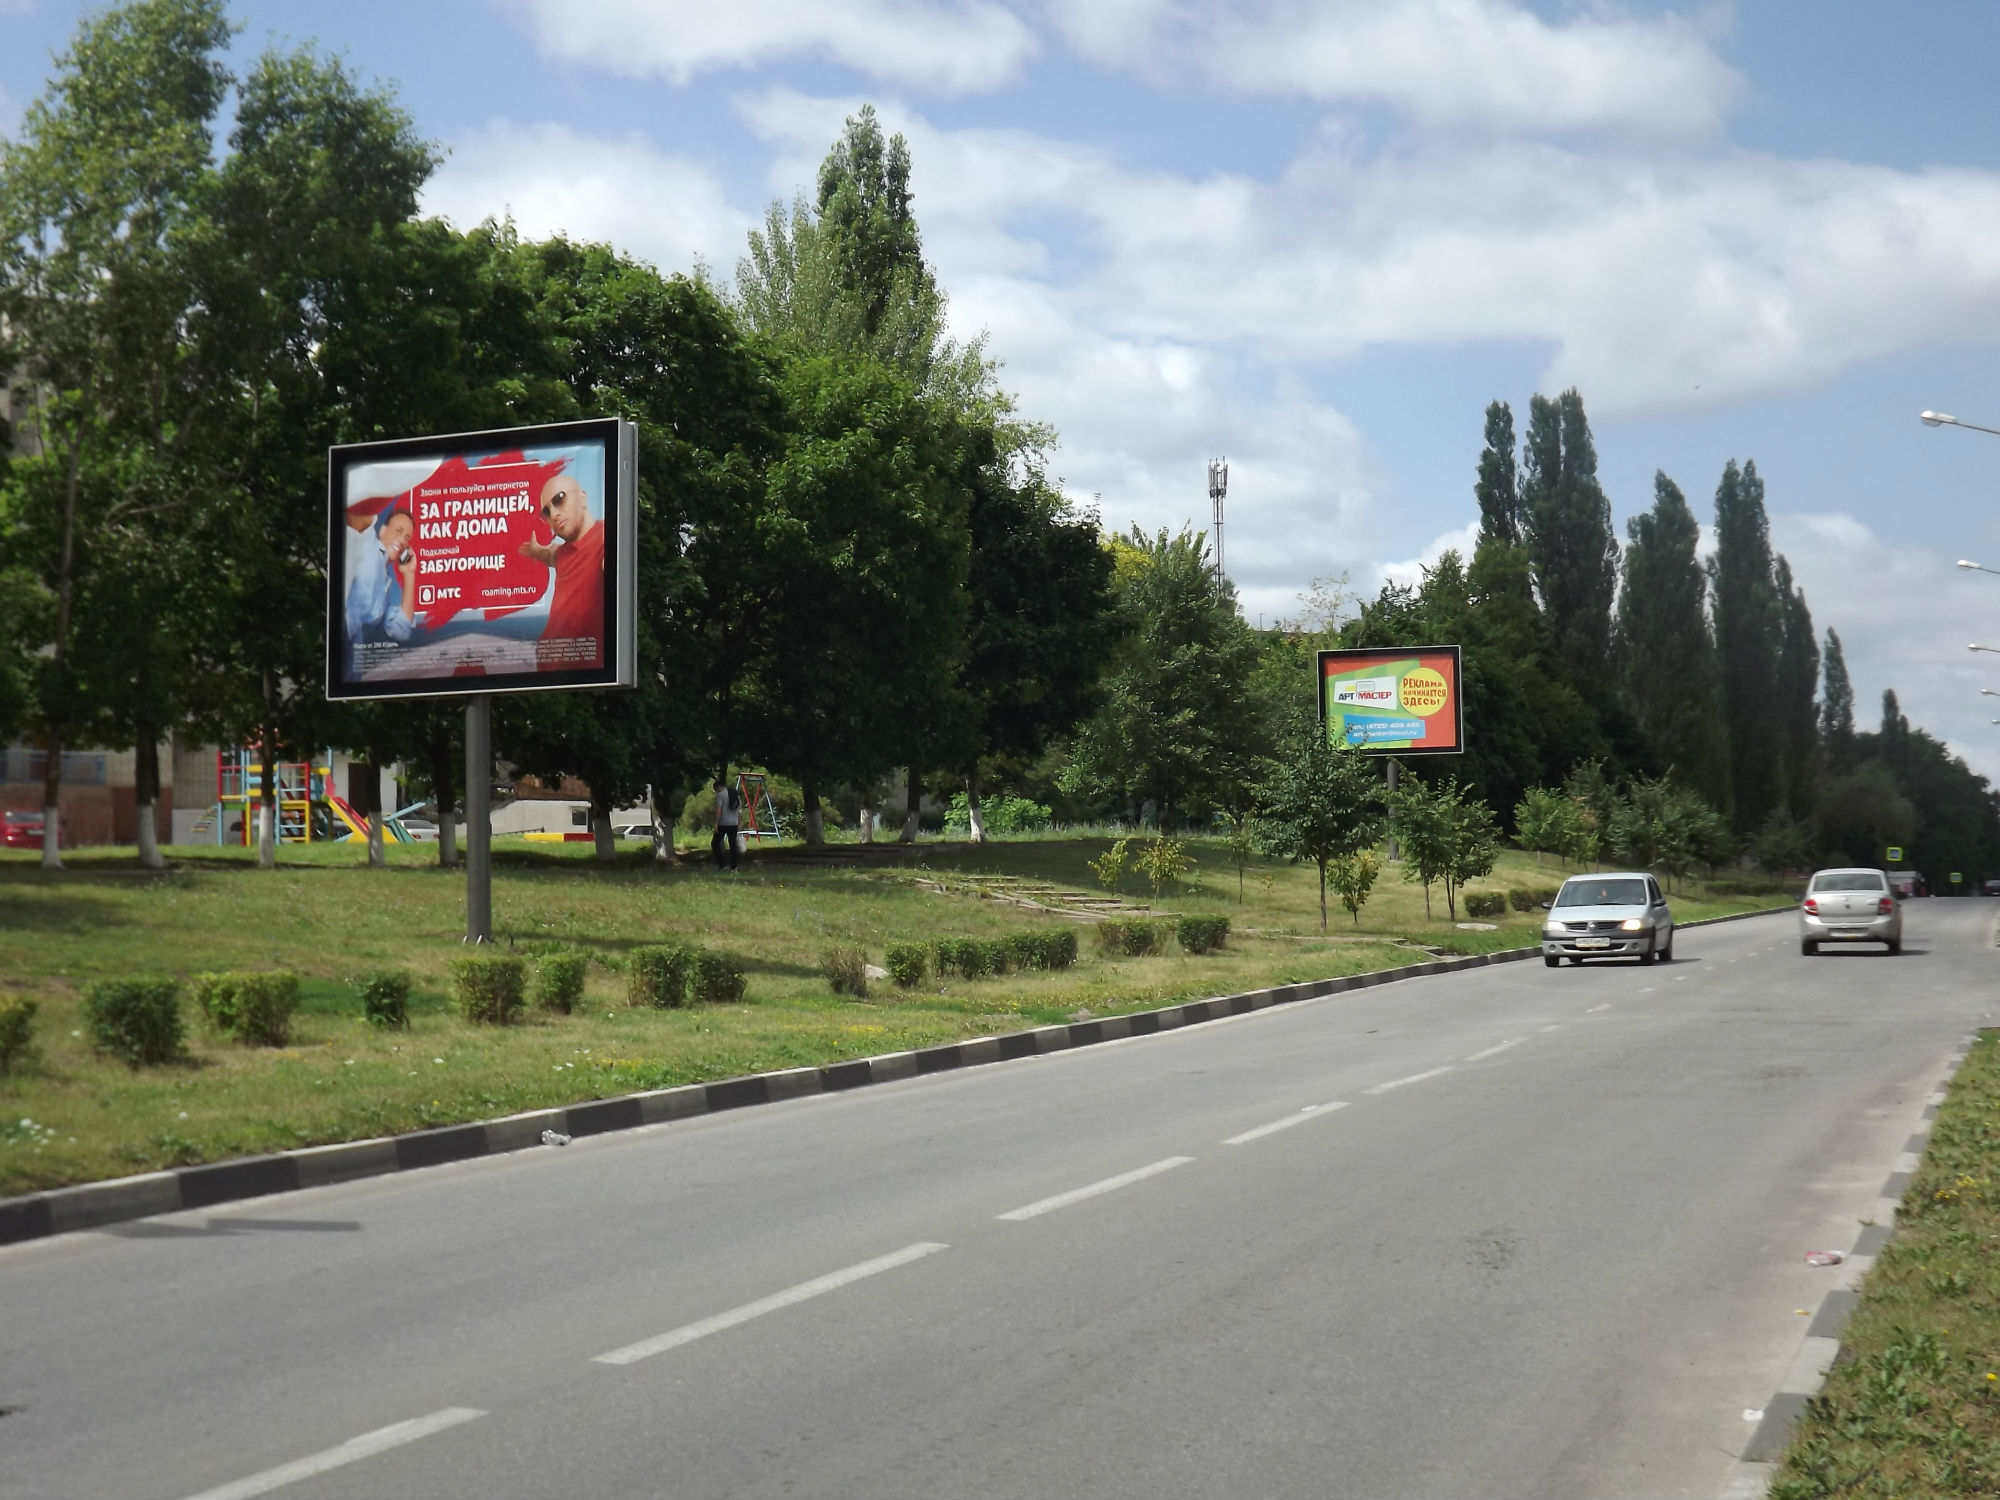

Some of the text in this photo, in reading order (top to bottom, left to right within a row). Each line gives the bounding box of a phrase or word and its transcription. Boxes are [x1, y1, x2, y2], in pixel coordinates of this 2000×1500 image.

[421, 488, 441, 496] Звони
[450, 484, 485, 494] пользуйся
[487, 480, 530, 491] интернетом
[420, 490, 535, 520] ЗА ГРАНИЦЕЙ,
[420, 517, 508, 540] КАК ДОМА
[420, 546, 460, 557] Подключай
[420, 554, 506, 574] ЗАБУГОРИЩЕ
[437, 587, 462, 600] МТС
[482, 586, 537, 597] roaming.mts.ru
[1403, 677, 1443, 689] РЕКЛАМА
[1338, 691, 1392, 701] АРТ МАСТЕР
[1403, 689, 1447, 697] НАЧИНАЕТСЯ
[1403, 696, 1440, 707] ЗДЕСЬ!
